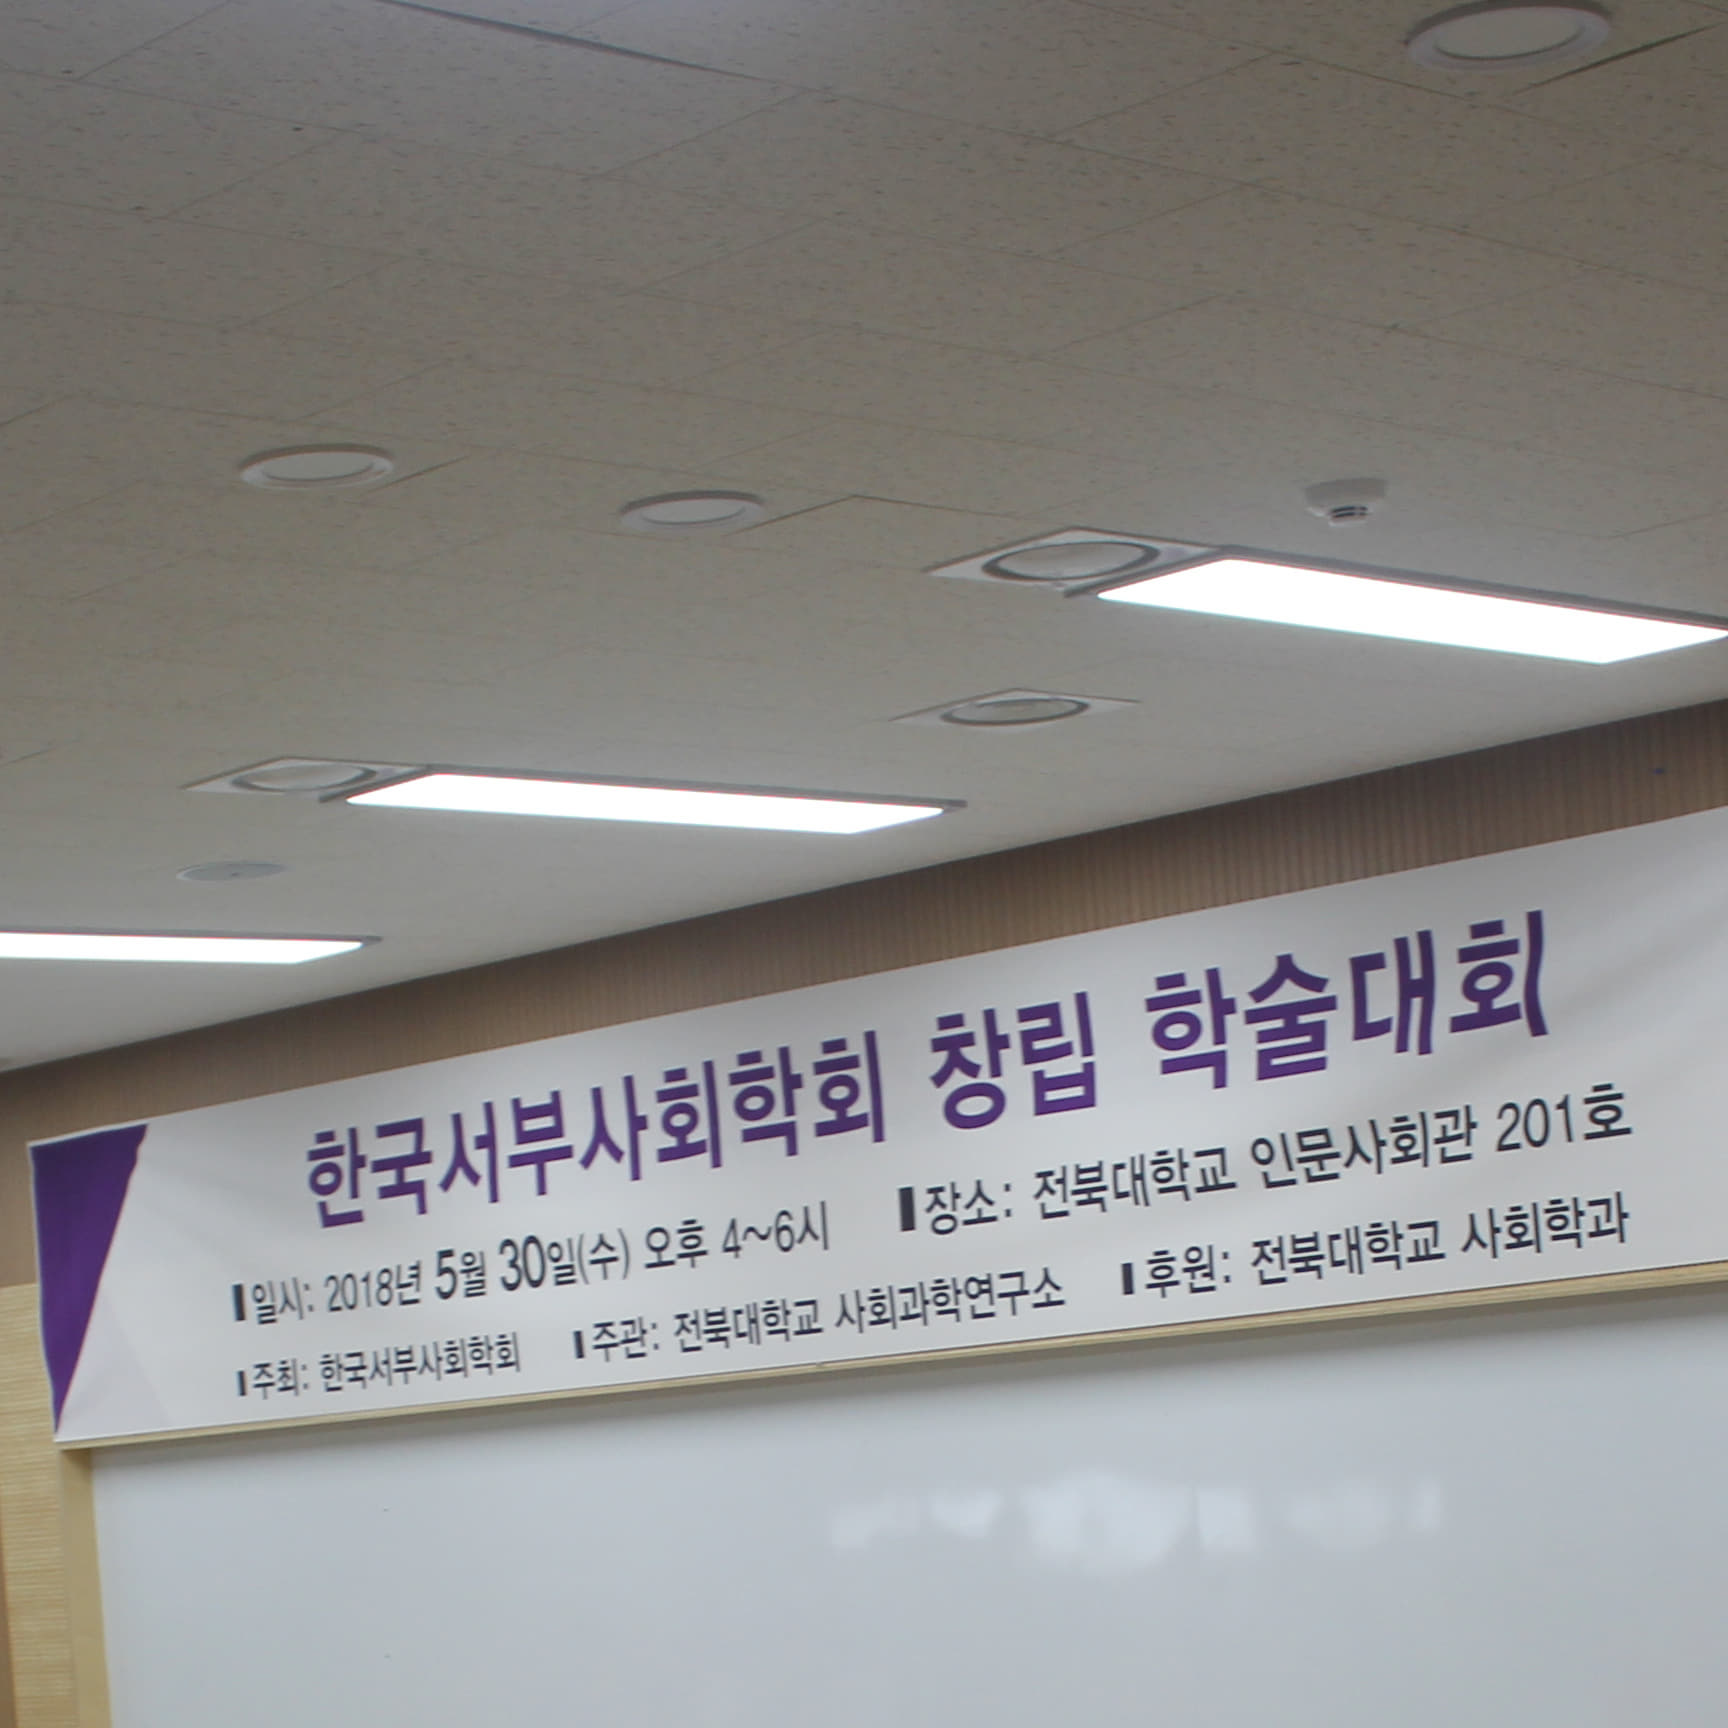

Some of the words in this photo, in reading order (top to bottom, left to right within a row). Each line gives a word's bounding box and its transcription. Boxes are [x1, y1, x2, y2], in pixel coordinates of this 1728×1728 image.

[306, 1029, 888, 1228] 한국서부사회학회
[929, 990, 1101, 1131] 창립
[1145, 908, 1550, 1090] 학술대회
[925, 1180, 1012, 1236] 장소:
[1033, 1145, 1237, 1221] 전북대학교
[1251, 1102, 1479, 1190] 인문사회관
[1496, 1082, 1633, 1154] 201호
[252, 1277, 315, 1326] 일시:
[326, 1259, 423, 1313] 2018년
[434, 1249, 487, 1300] 5월
[499, 1227, 632, 1292] 30일(수)
[645, 1219, 709, 1270] 오후
[722, 1201, 831, 1259] 4~6시
[1145, 1245, 1232, 1298] 후원:
[1250, 1215, 1446, 1286] 전북대학교
[1461, 1190, 1630, 1259] 사회학과
[252, 1366, 309, 1398] 주최:
[320, 1332, 521, 1394] 한국서부사회학회
[592, 1317, 660, 1364] 주관:
[673, 1295, 824, 1354] 전북대학교
[834, 1265, 1066, 1336] 사회과학연구소
